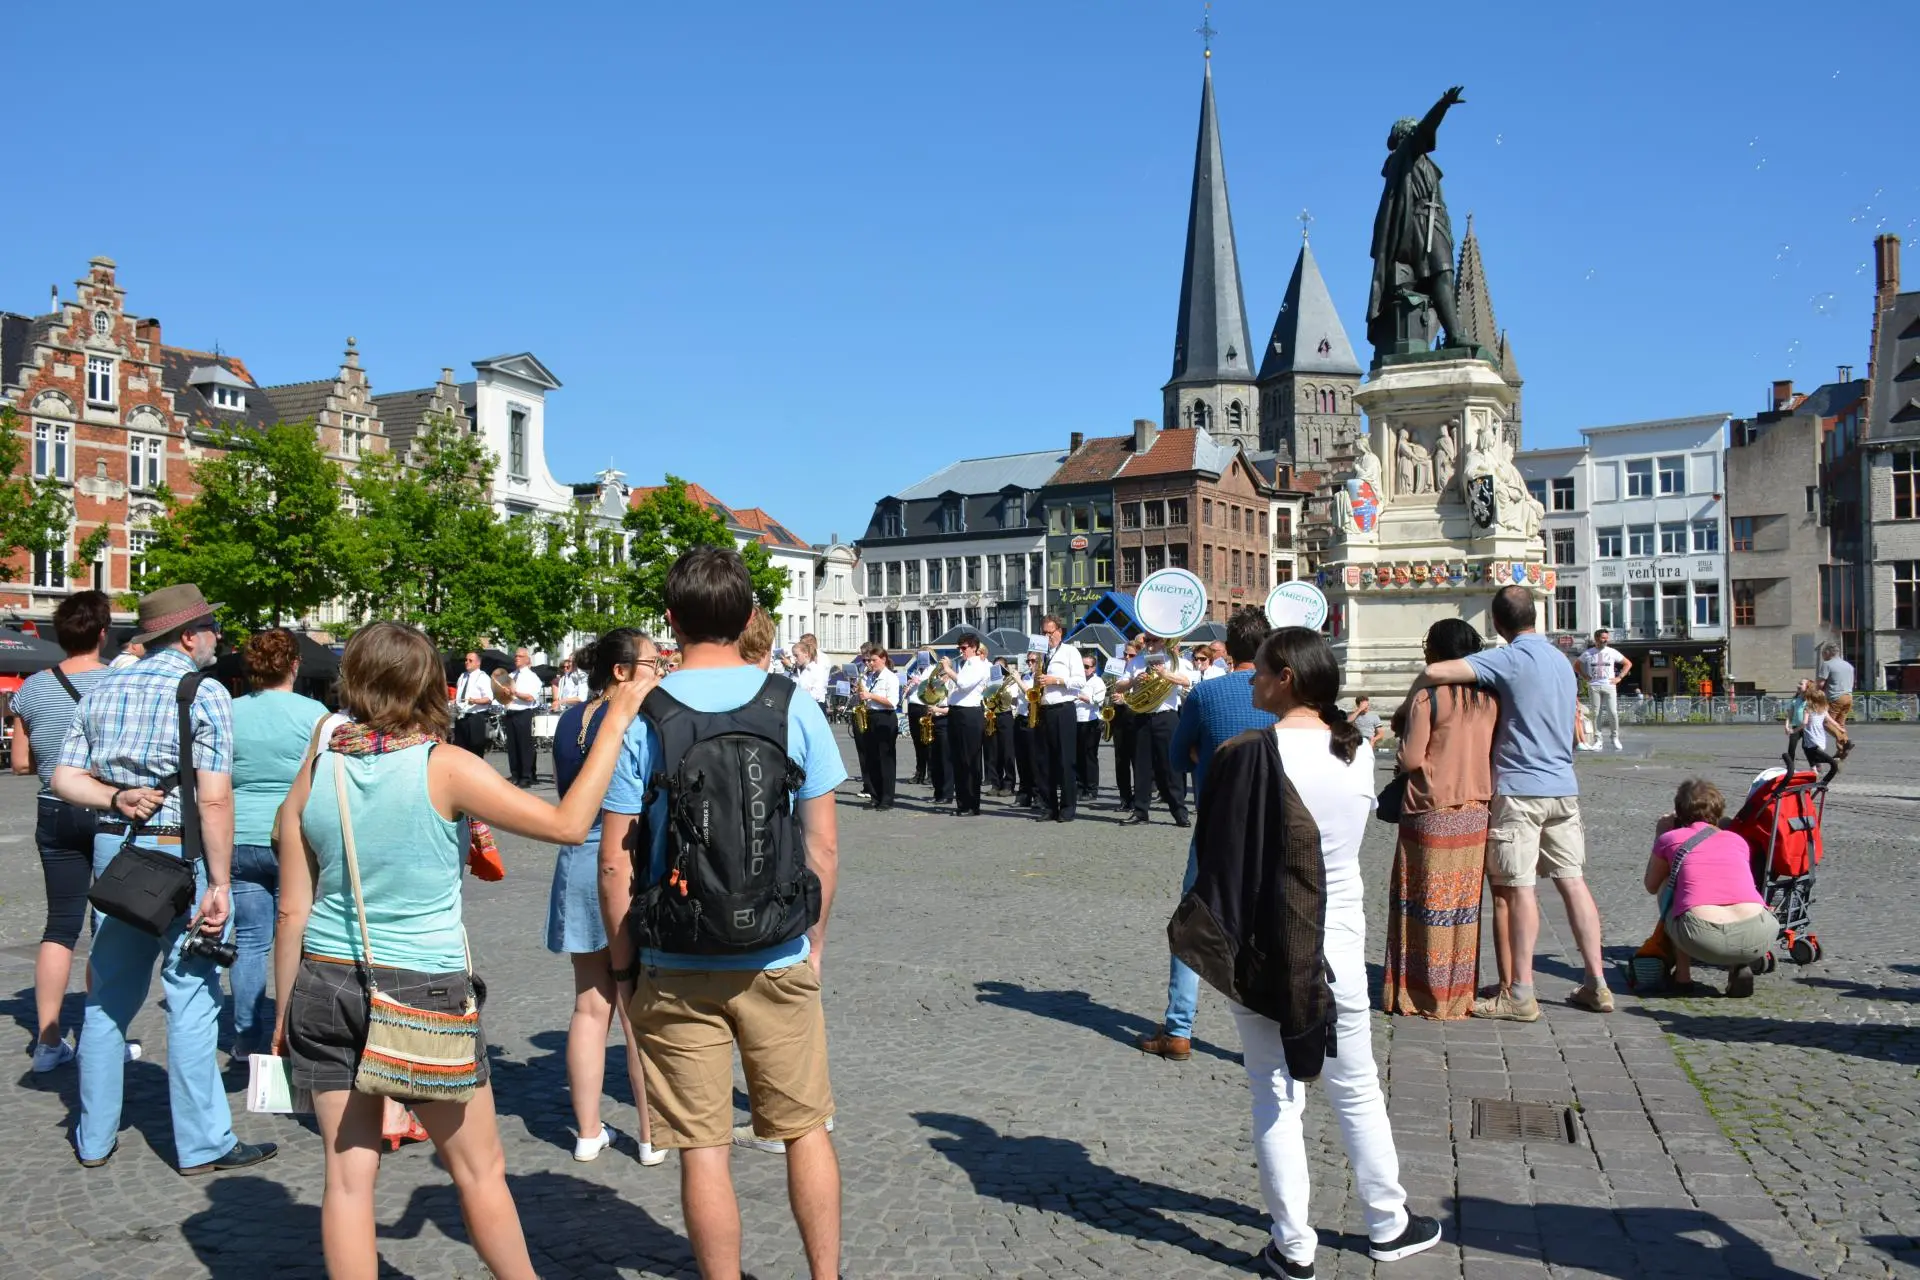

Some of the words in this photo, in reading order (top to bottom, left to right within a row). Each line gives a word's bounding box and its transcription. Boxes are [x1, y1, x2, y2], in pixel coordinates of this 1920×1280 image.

[1628, 564, 1681, 579] ventura
[1147, 584, 1194, 596] AMICITIA
[1279, 591, 1318, 606] AMICITIA
[703, 800, 709, 808] 22
[745, 747, 765, 876] ORTOVOX
